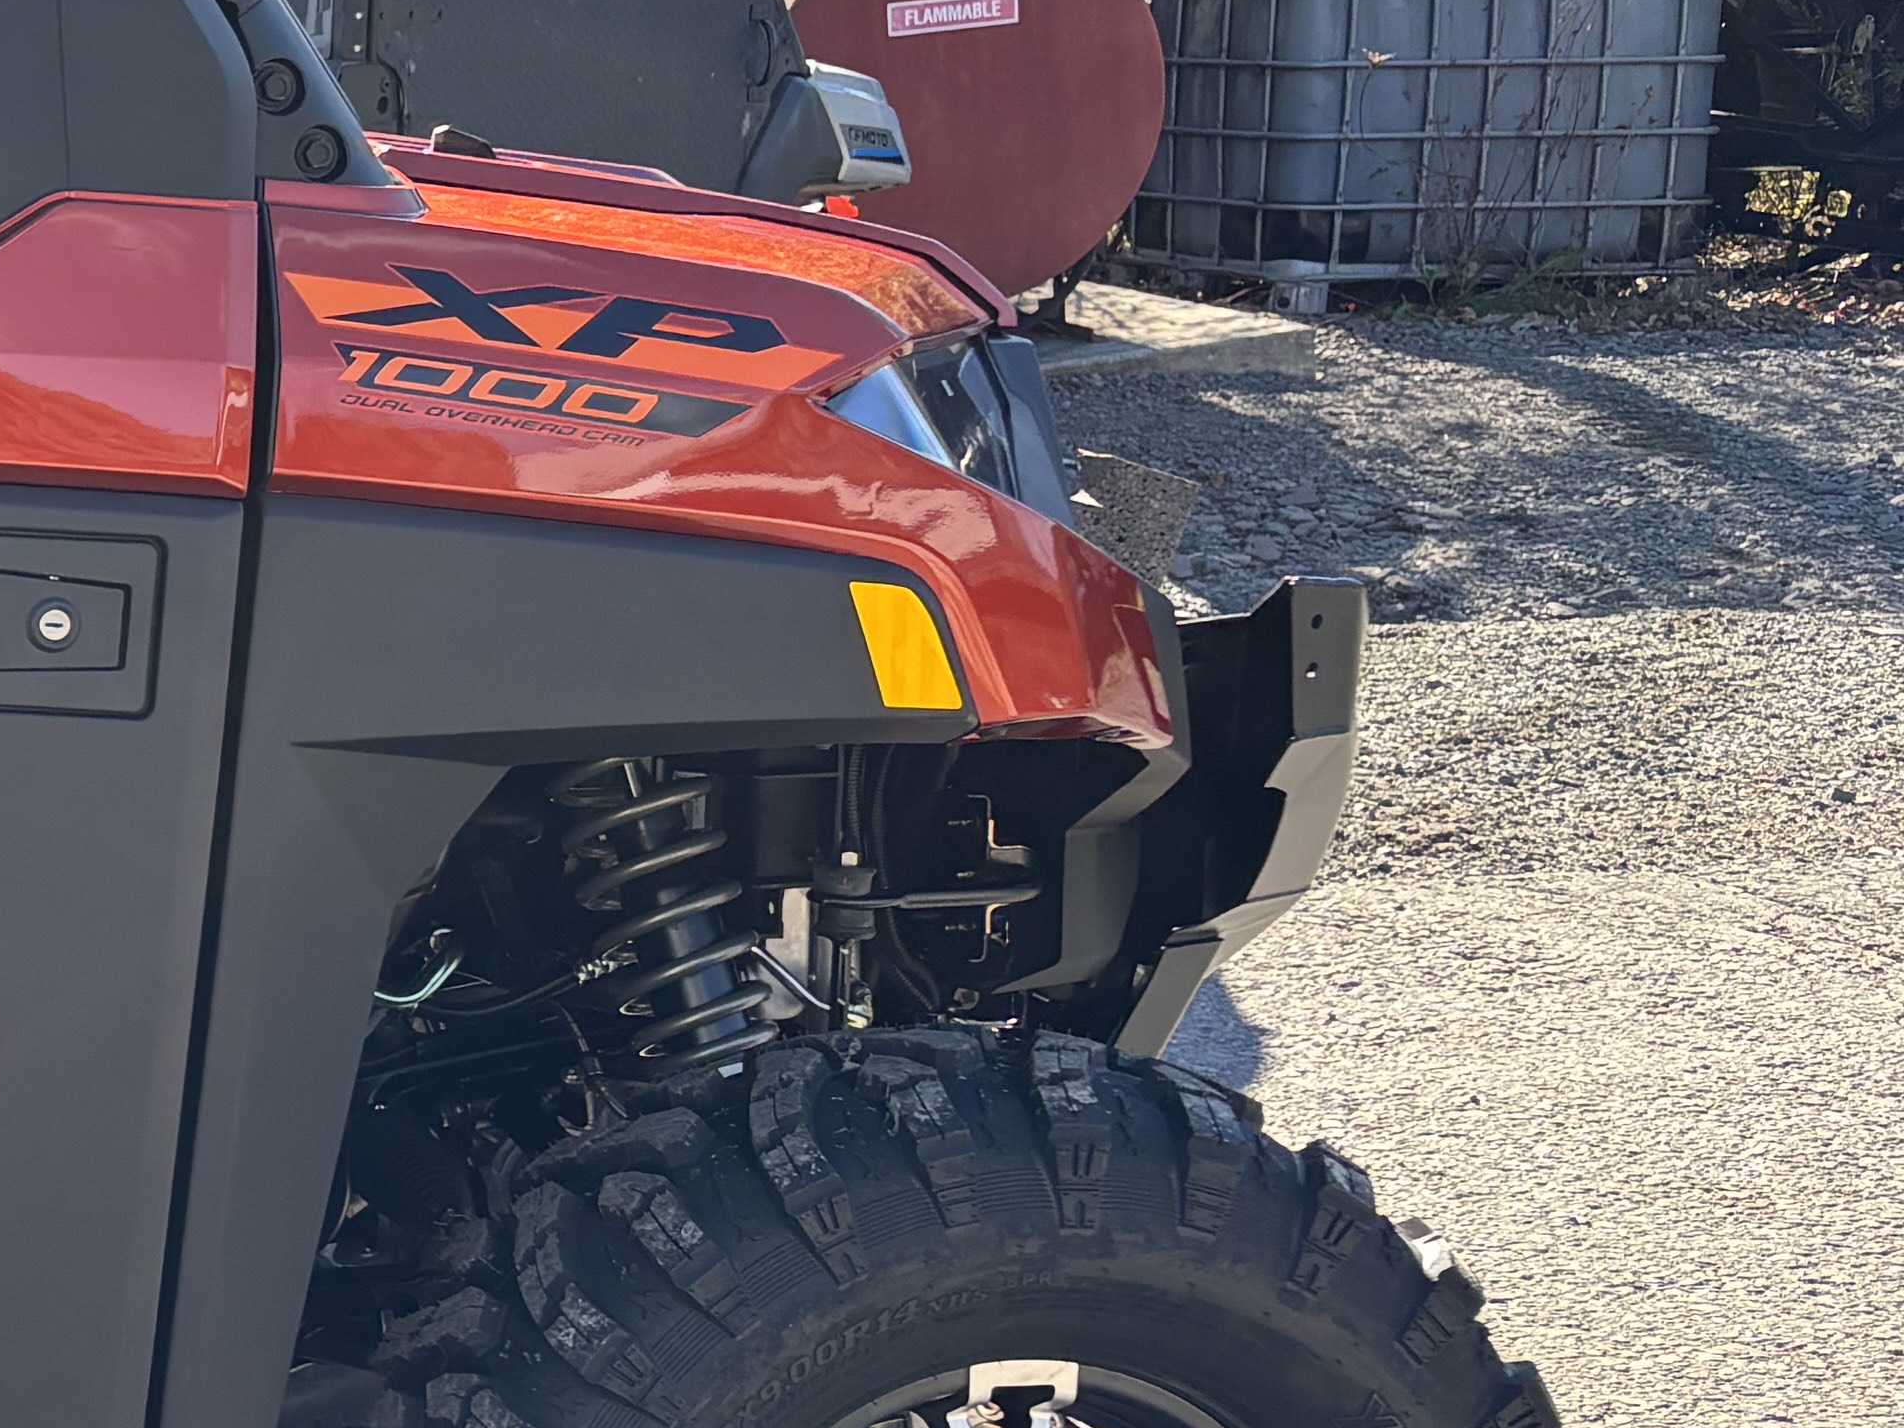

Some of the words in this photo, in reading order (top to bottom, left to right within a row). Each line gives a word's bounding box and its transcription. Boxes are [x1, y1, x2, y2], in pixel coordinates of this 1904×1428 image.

[904, 0, 1002, 27] FLAMMABLE
[323, 262, 789, 358] XP
[338, 350, 660, 424] 1000
[340, 394, 416, 414] DUAL
[424, 405, 579, 437] OVERHEAD
[581, 429, 646, 448] CAM
